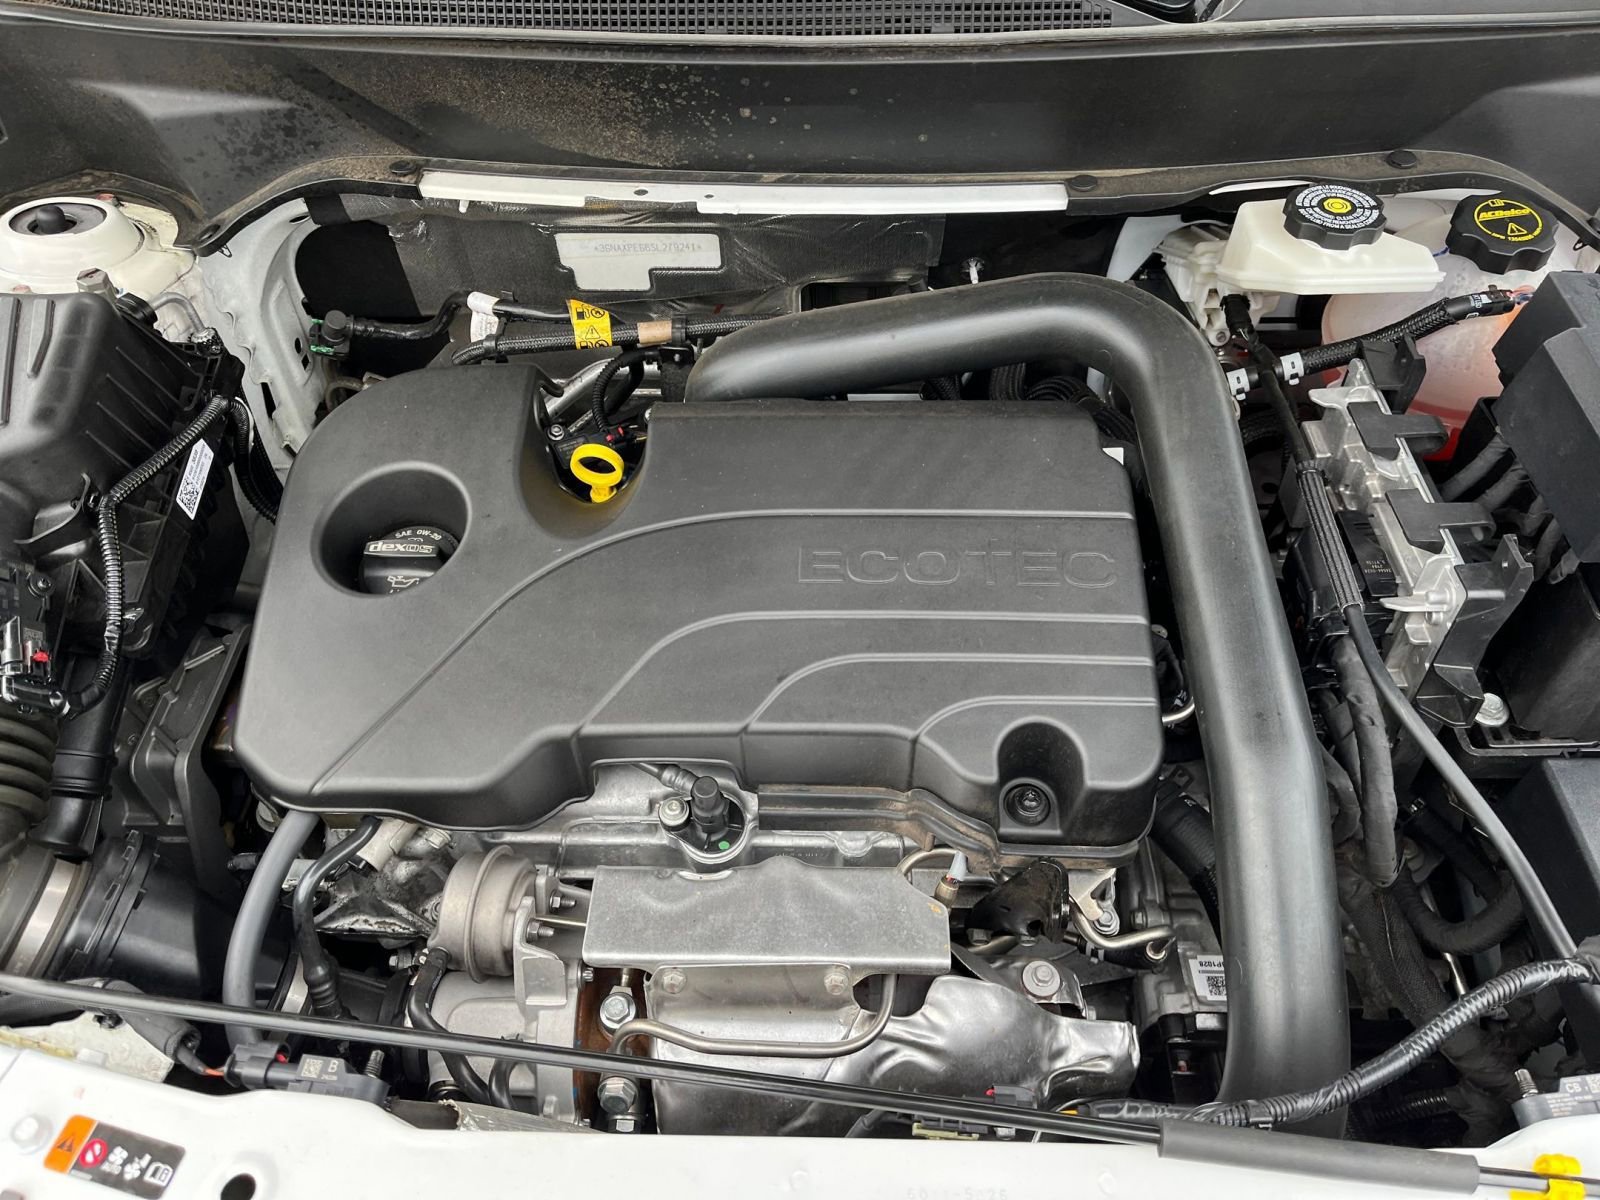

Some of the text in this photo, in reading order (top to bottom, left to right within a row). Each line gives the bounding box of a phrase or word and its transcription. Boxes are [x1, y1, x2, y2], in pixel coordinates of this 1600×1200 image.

[395, 529, 413, 539] SAE
[368, 541, 435, 553] dexos
[798, 541, 1117, 588] ECOTEC
[327, 1060, 339, 1073] B
